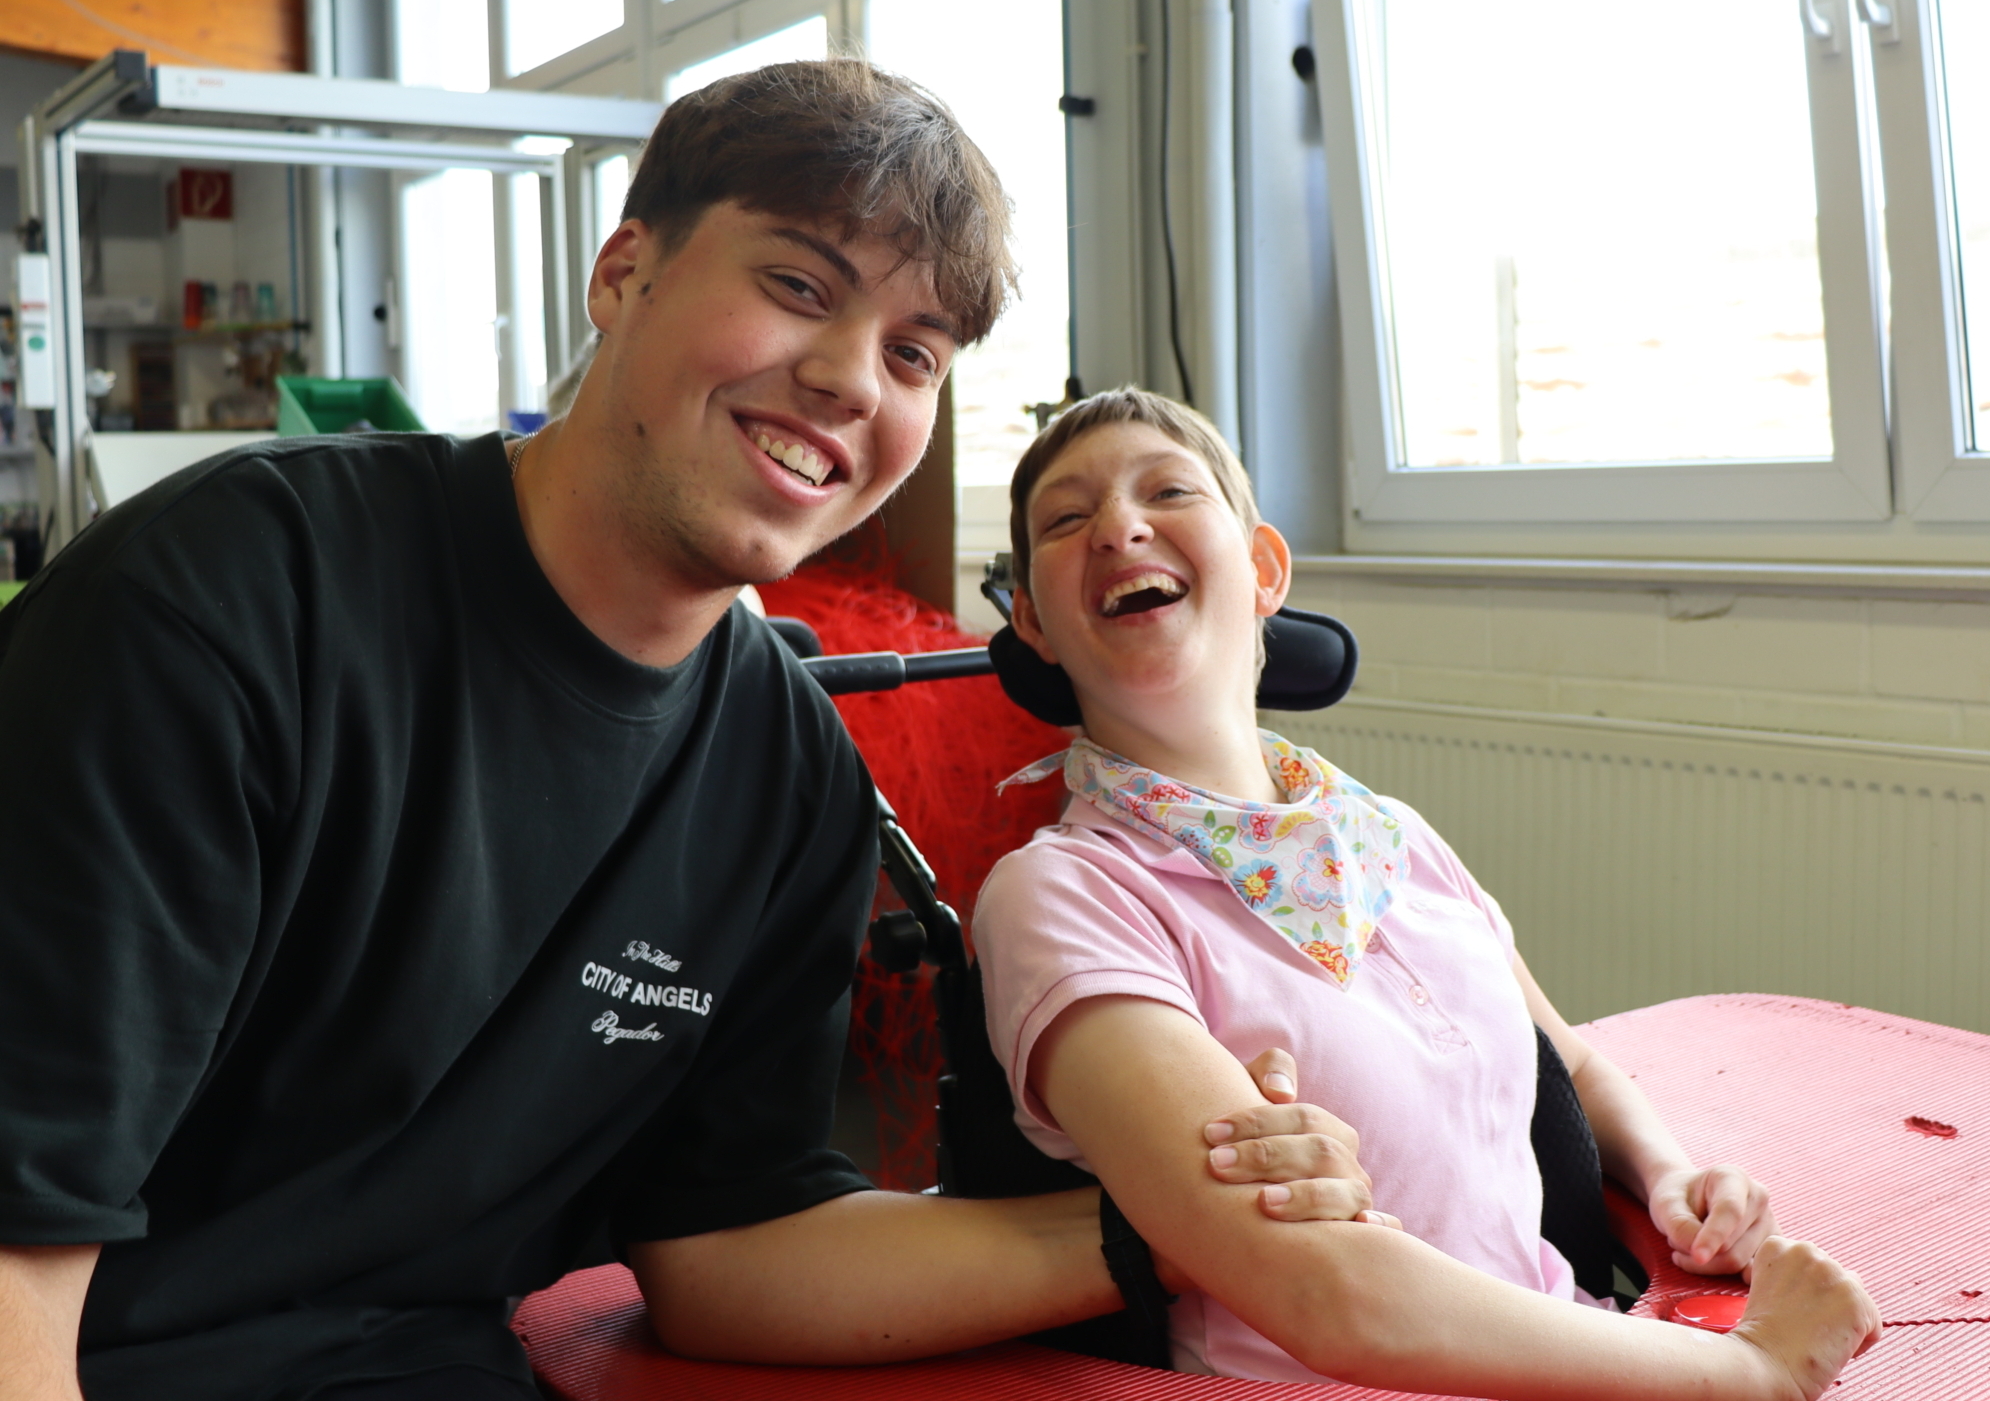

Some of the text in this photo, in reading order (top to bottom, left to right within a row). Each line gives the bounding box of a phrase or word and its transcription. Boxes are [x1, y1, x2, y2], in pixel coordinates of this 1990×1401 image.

[648, 949, 683, 973] Hills
[582, 961, 713, 1016] CITY OF ANGELS
[591, 1009, 665, 1045] Pegador
